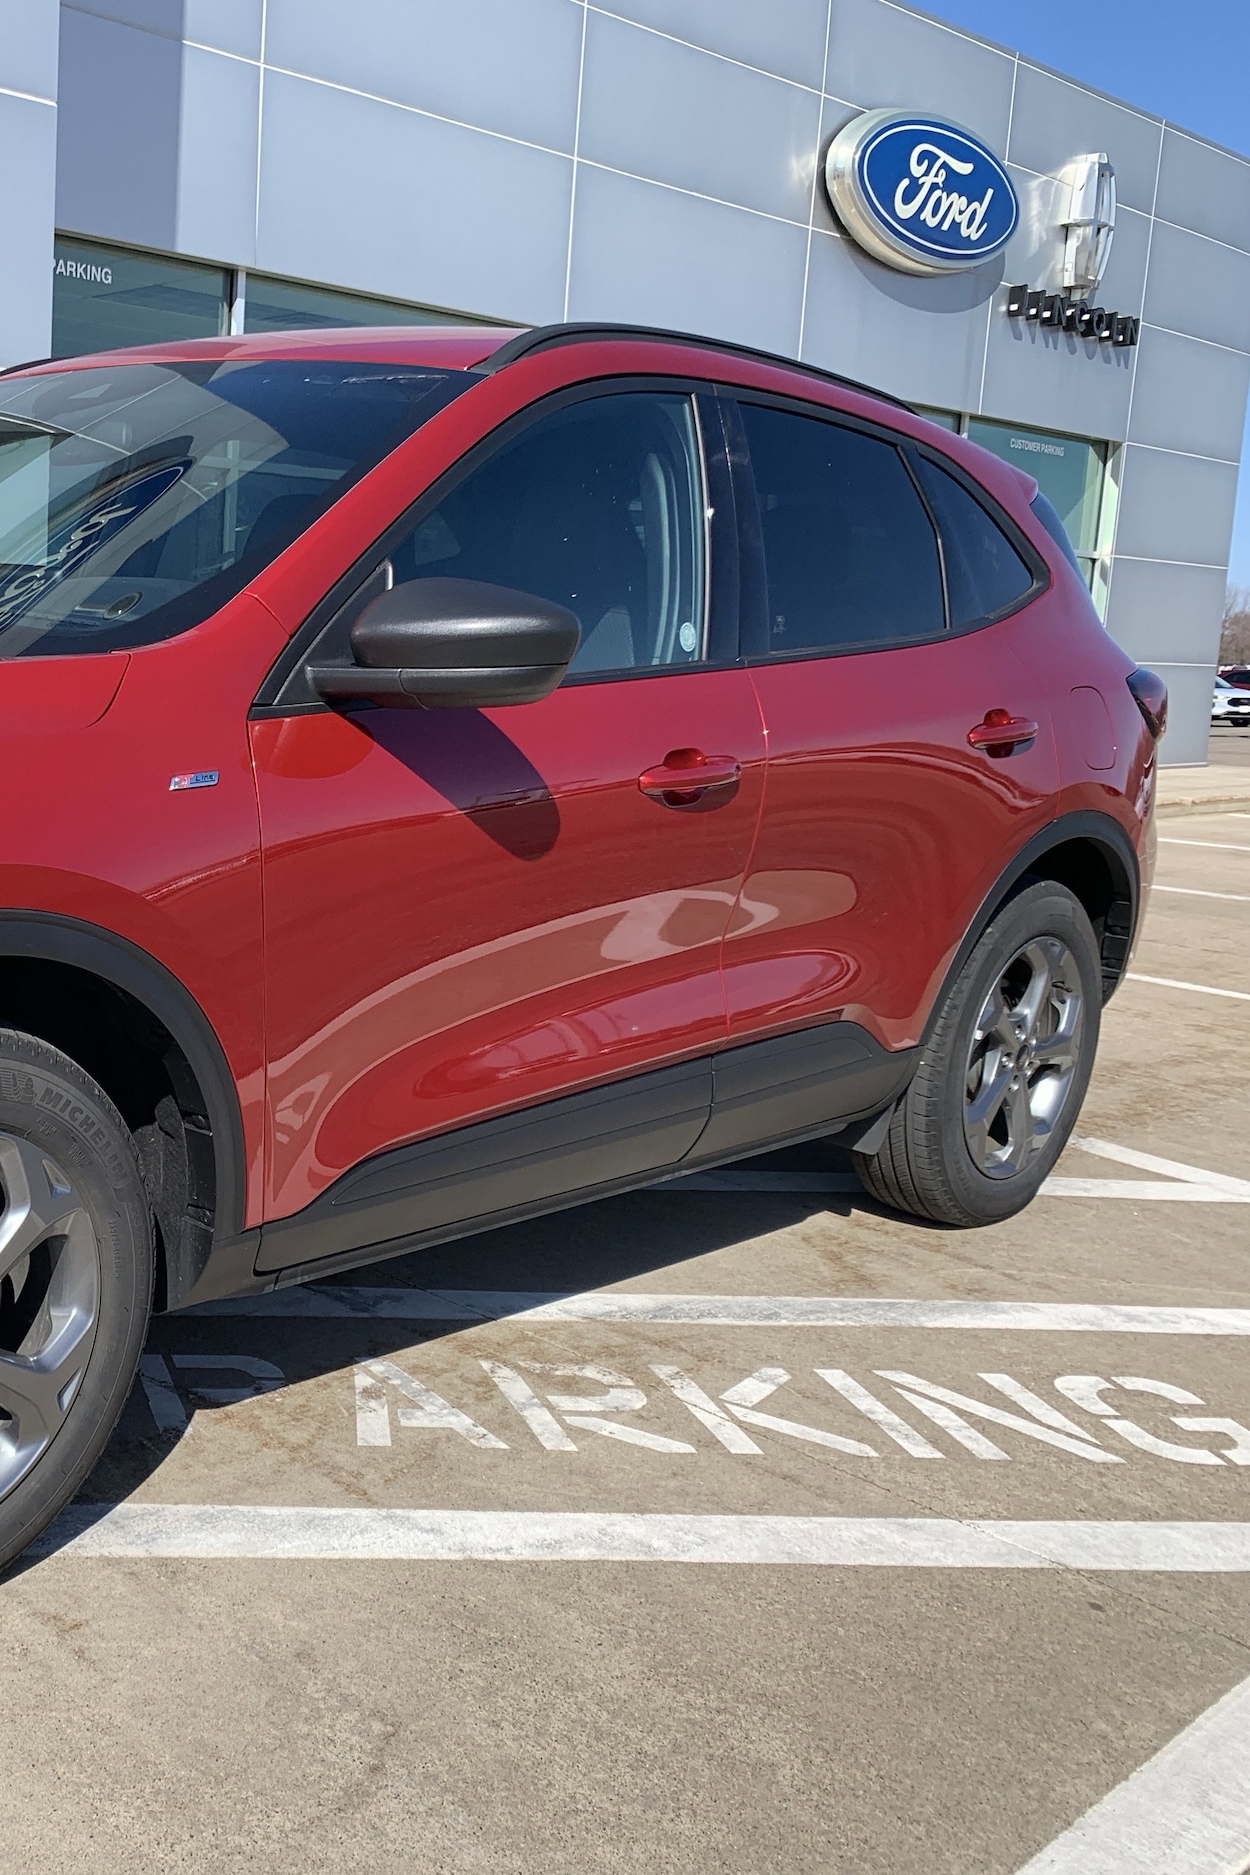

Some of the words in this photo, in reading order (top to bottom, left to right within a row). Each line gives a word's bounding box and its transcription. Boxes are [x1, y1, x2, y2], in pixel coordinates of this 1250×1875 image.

[895, 143, 994, 241] Ford
[1010, 438, 1040, 452] CUSTOMER
[1040, 443, 1064, 456] PARKING
[39, 1086, 128, 1182] MICHELIN
[141, 1353, 1250, 1466] PARKING
